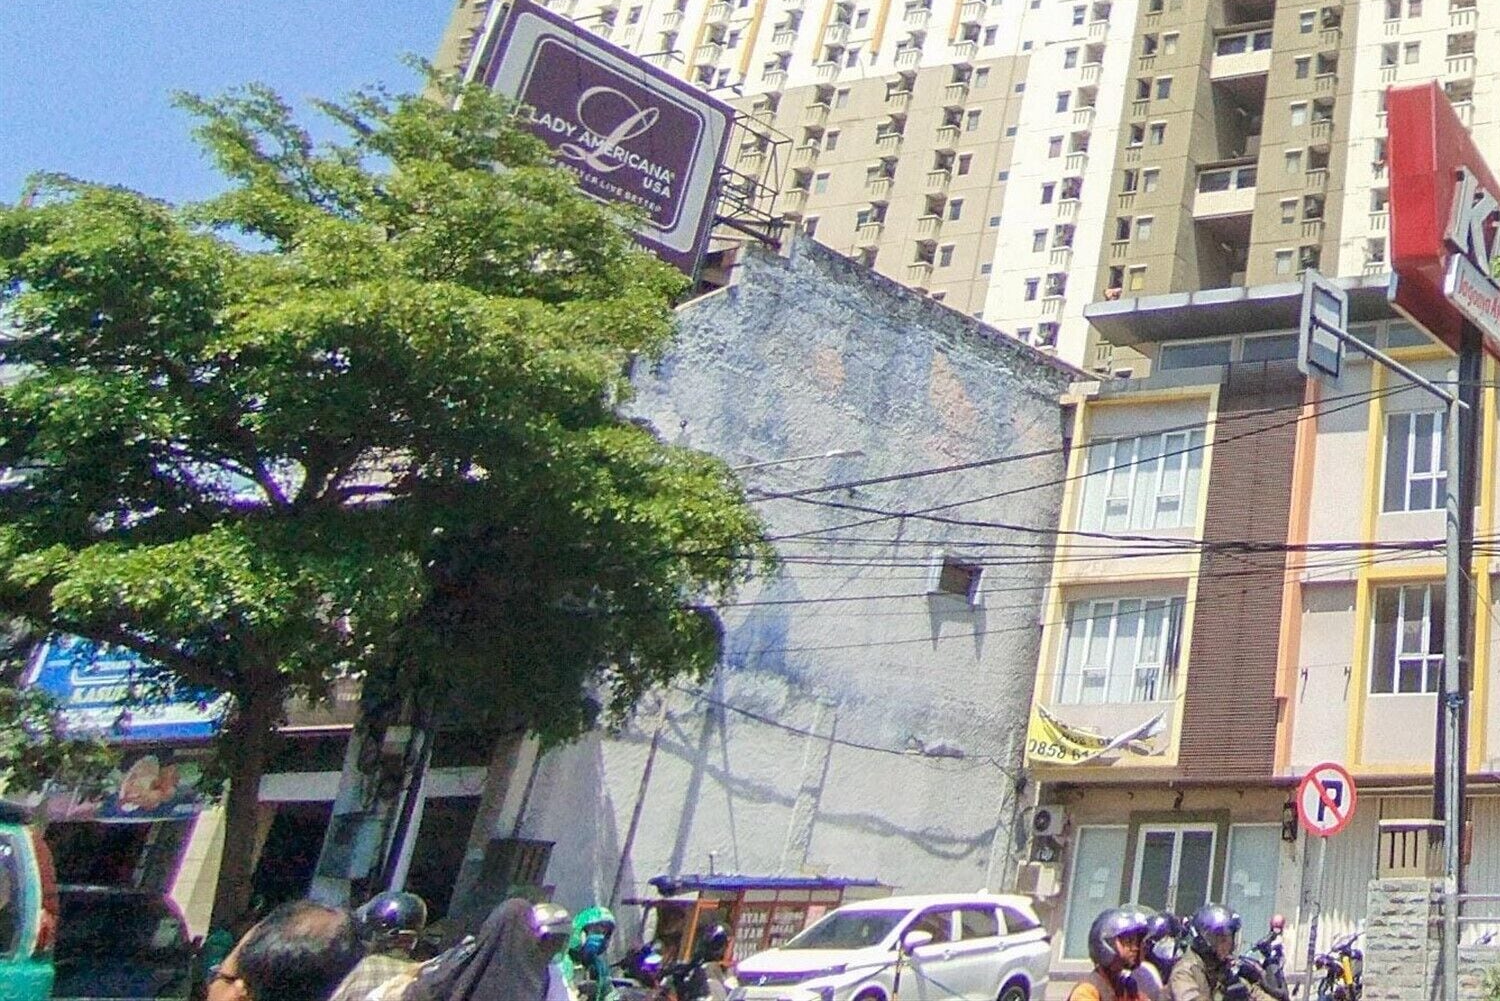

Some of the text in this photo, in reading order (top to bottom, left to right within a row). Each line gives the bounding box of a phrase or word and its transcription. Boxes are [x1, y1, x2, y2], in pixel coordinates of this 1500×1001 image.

[529, 106, 577, 137] LADY
[643, 176, 671, 199] USA
[1317, 780, 1343, 821] P
